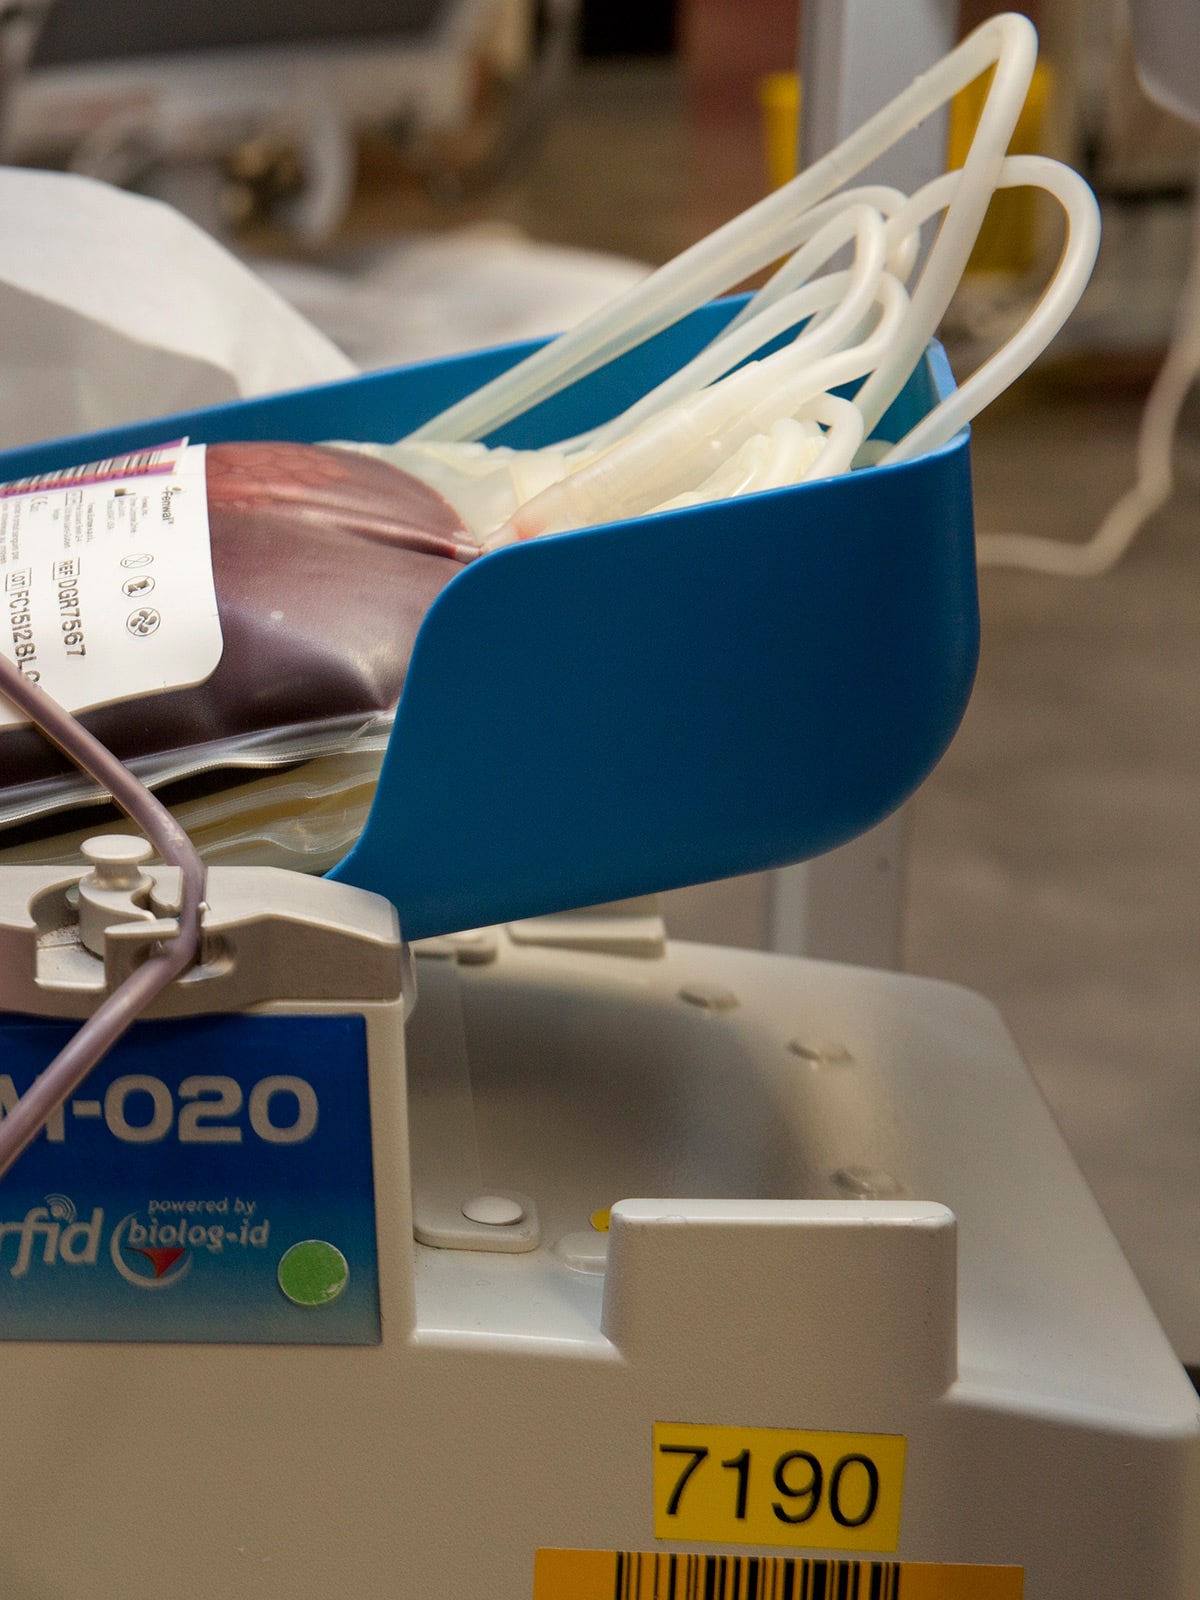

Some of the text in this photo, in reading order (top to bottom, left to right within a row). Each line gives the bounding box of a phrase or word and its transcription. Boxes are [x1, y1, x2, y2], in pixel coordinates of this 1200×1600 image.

[11, 570, 26, 587] LOT
[59, 560, 73, 576] REF
[58, 578, 86, 656] DGR7567
[148, 1197, 256, 1215] powered by
[127, 1217, 270, 1252] biolog-id
[659, 1443, 880, 1527] 7190
